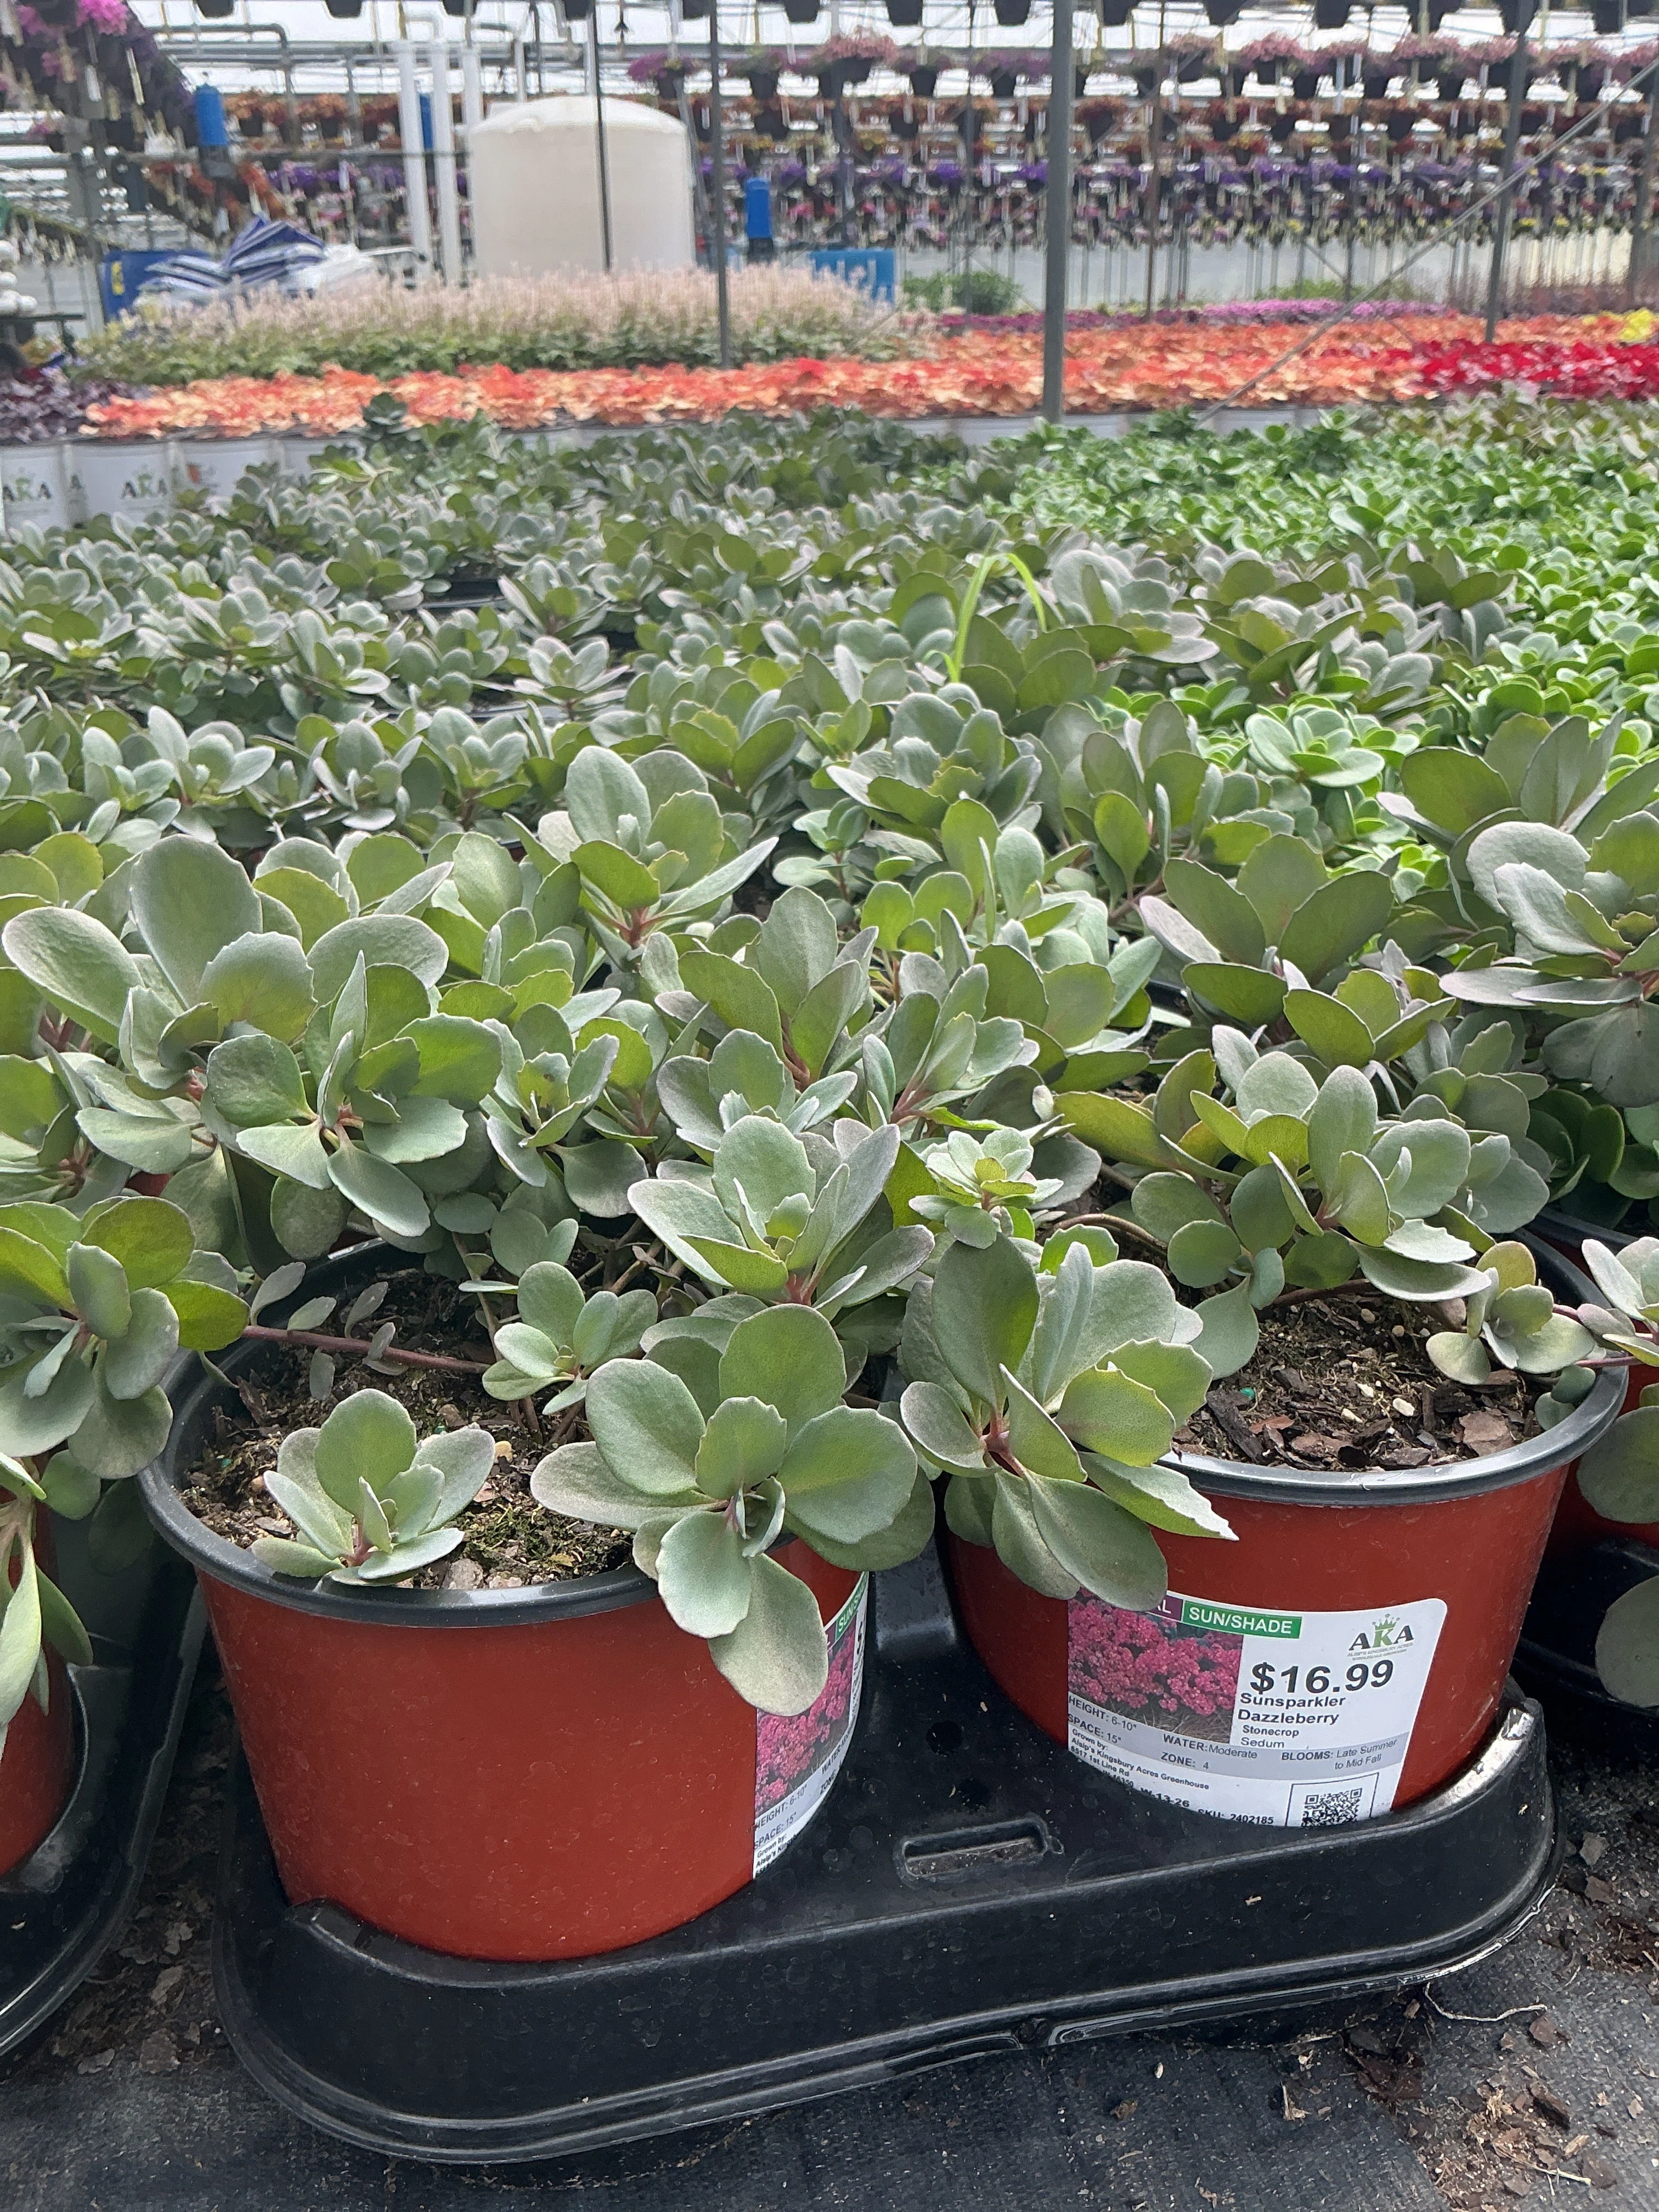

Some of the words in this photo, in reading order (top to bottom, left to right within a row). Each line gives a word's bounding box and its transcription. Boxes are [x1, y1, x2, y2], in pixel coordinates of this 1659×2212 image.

[1189, 1607, 1293, 1634] SUN/SHADE
[1348, 1618, 1414, 1651] AKA
[1250, 1660, 1394, 1695] $16.99
[1069, 1695, 1109, 1722] HEIGHT:
[1111, 1716, 1137, 1731] 6-10"
[1240, 1692, 1346, 1710] Sunsparkler
[1068, 1713, 1104, 1738] SPACE:
[1107, 1733, 1121, 1744] 15"
[1237, 1708, 1340, 1725] Dazzleberry
[1072, 1728, 1096, 1745] Grown
[1097, 1740, 1109, 1751] by:
[1240, 1737, 1285, 1748] Sedum
[1242, 1724, 1300, 1738] Stonecrop
[1163, 1734, 1207, 1752] WATER:
[1209, 1744, 1257, 1759] Moderate
[1281, 1751, 1333, 1761] BLOOMS:
[1336, 1748, 1358, 1758] Late
[1359, 1739, 1398, 1754] Summer
[1070, 1745, 1088, 1758] 6517
[1089, 1754, 1101, 1765] 1st
[1101, 1760, 1118, 1773] Line
[1119, 1767, 1130, 1778] Rd
[1097, 1749, 1135, 1771] Kingsbury
[1136, 1765, 1159, 1779] Acres
[1160, 1773, 1210, 1790] Greenhouse
[1160, 1751, 1195, 1768] ZONE:
[1203, 1762, 1209, 1770] 4
[1334, 1761, 1344, 1770] to
[1346, 1759, 1363, 1768] Mid
[1365, 1753, 1382, 1765] Fall
[755, 1802, 788, 1830] HEIGHT:
[789, 1784, 808, 1805] 6-10"
[754, 1822, 785, 1850] SPACE:
[786, 1811, 797, 1827] 15"
[1229, 1813, 1274, 1826] 2402185
[757, 1841, 777, 1859] Grown
